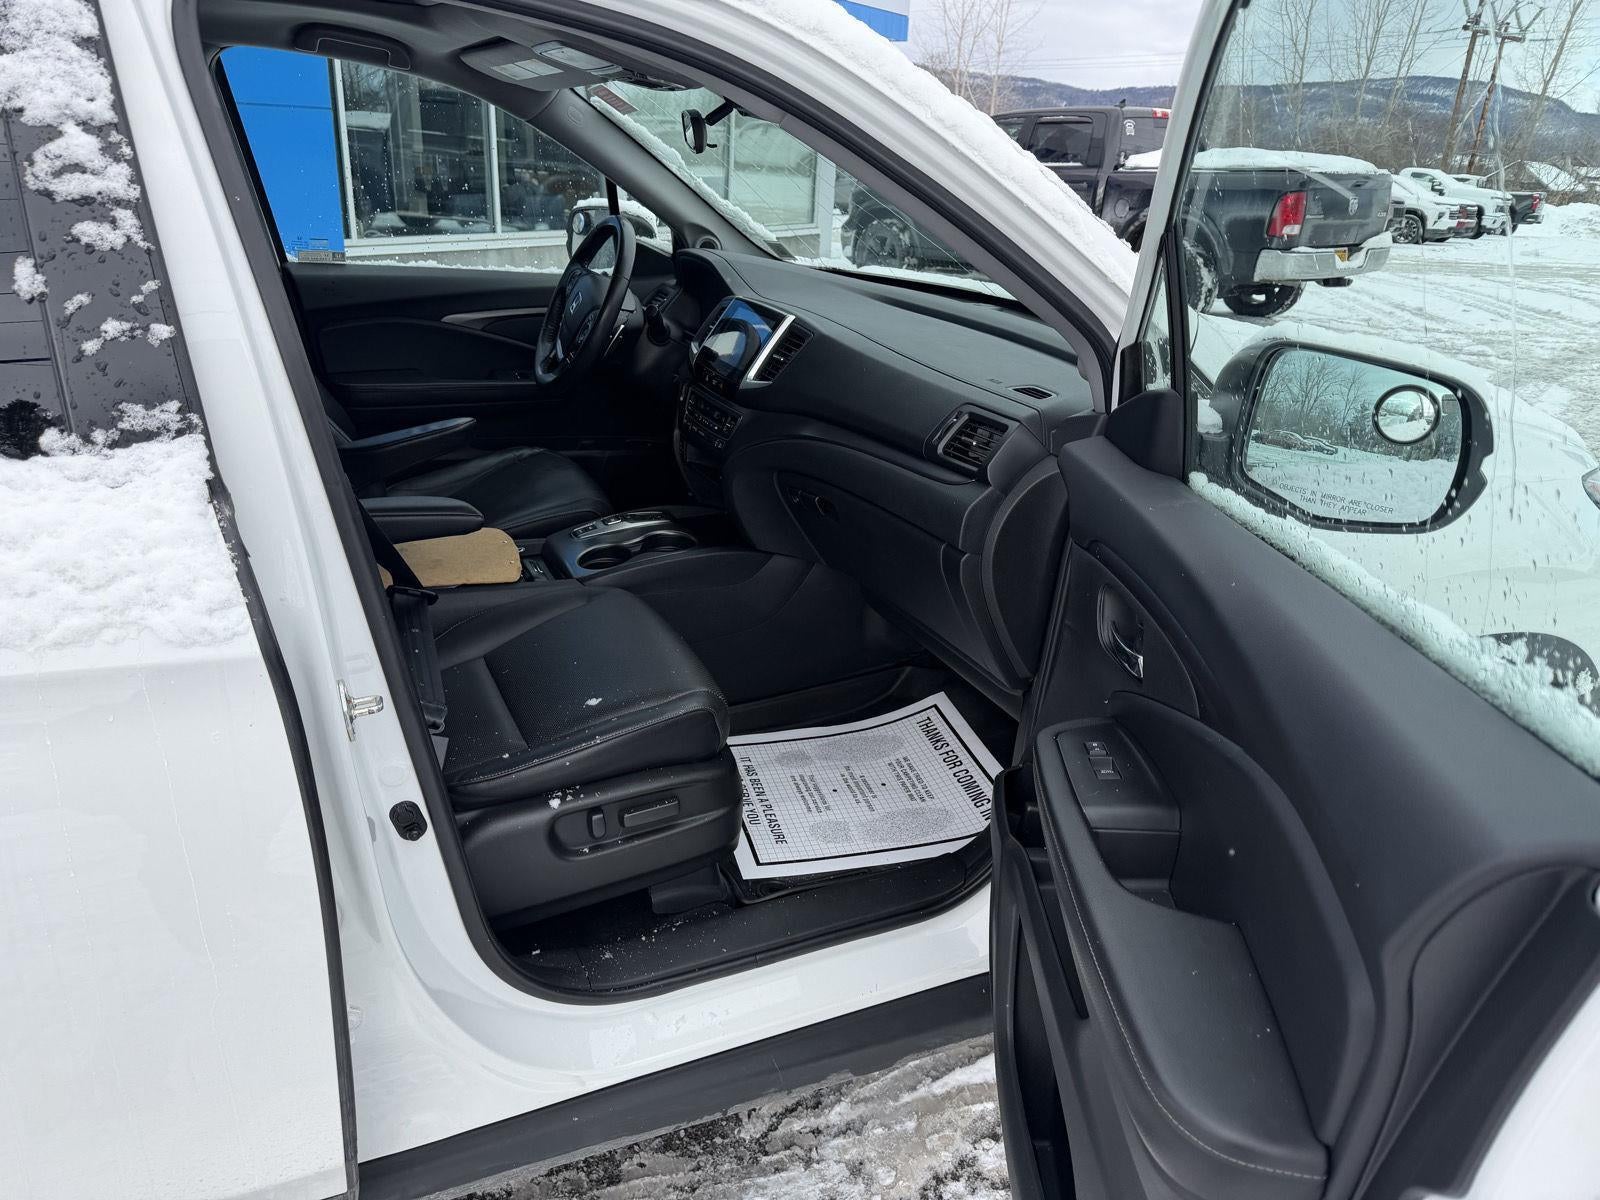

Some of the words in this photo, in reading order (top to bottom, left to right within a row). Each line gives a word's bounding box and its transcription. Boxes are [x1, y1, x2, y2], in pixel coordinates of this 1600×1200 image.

[1280, 484, 1306, 494] OBJECTS
[1321, 492, 1345, 503] MIRROR
[1367, 503, 1393, 514] CLOSER
[1300, 495, 1316, 504] THAN
[1321, 499, 1337, 509] THEY
[740, 755, 751, 763] IT
[917, 716, 949, 751] THANKS
[939, 749, 963, 770] FOR
[953, 768, 991, 808] COMING
[743, 764, 758, 777] HAS
[749, 778, 766, 796] BEEN
[745, 808, 761, 825] YOU
[761, 803, 788, 845] PLEASURE
